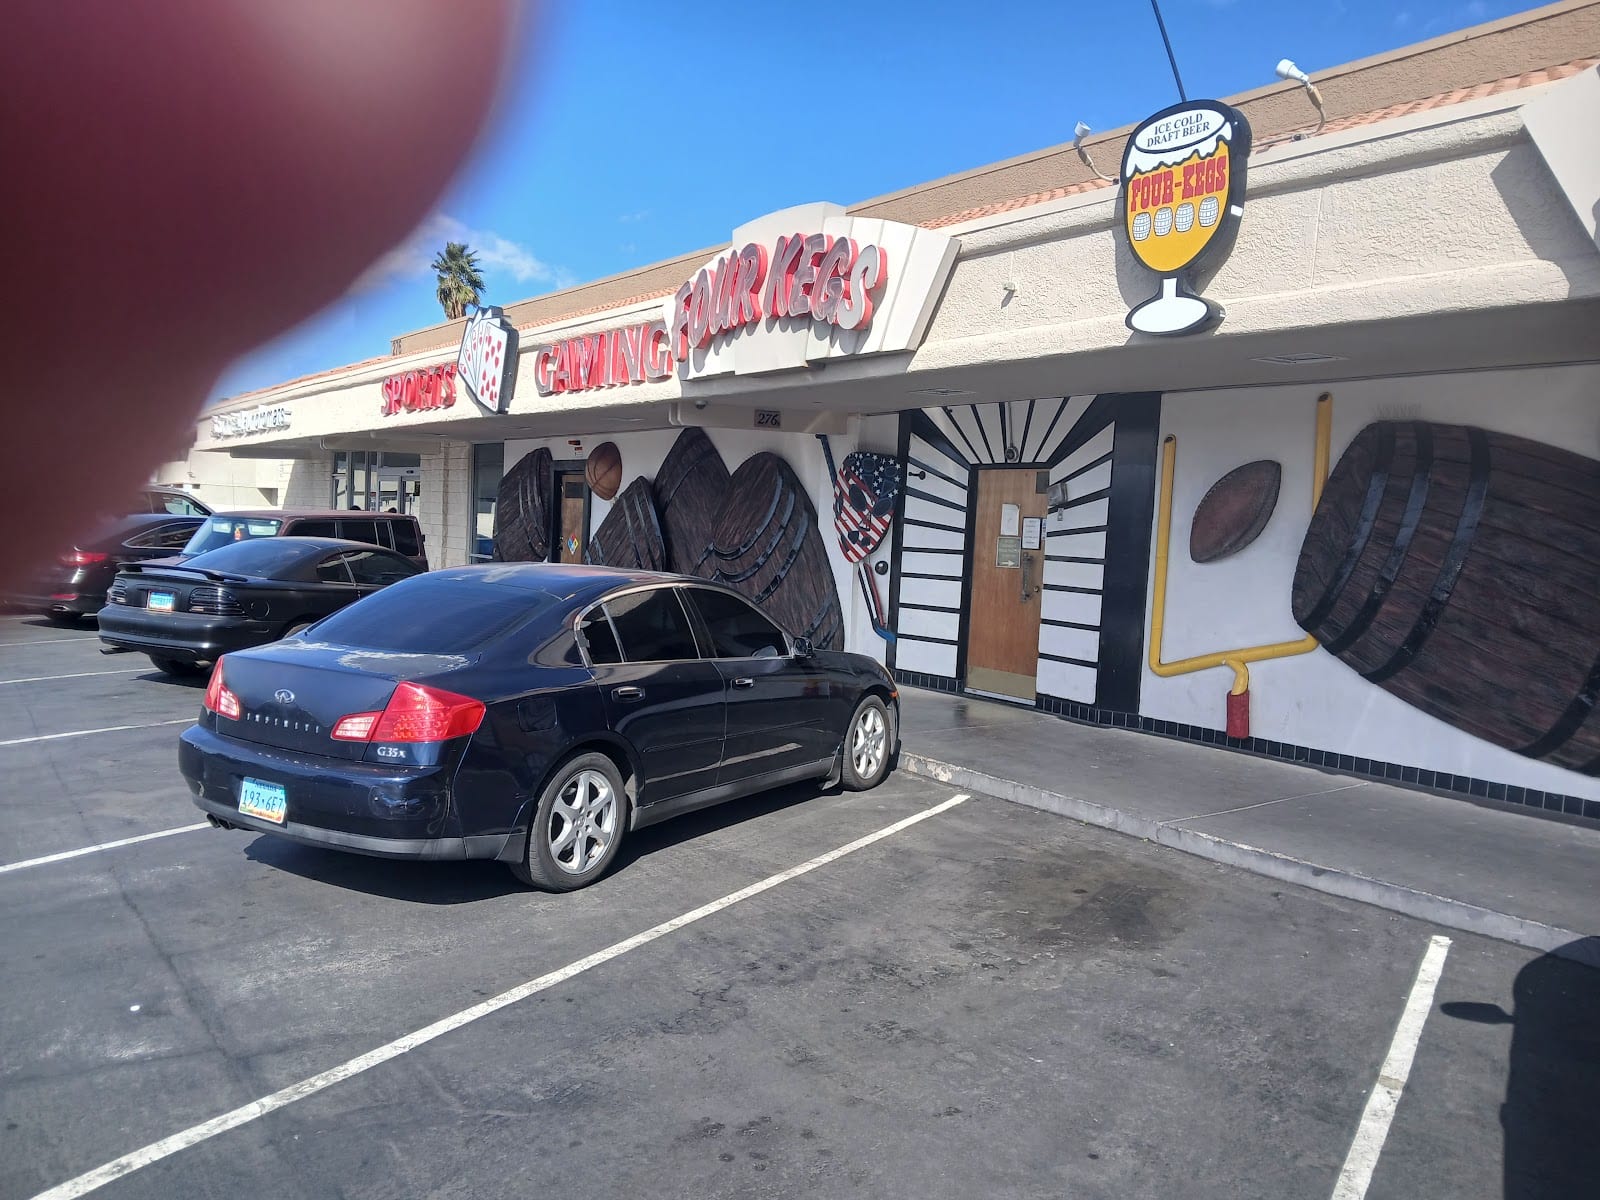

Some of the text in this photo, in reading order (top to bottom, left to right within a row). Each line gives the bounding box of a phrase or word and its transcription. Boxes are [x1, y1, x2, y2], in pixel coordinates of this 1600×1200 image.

[1147, 121, 1210, 147] DRAFT BEER
[1154, 113, 1203, 135] ICE COLD
[1130, 155, 1227, 212] FOUR-KEGS
[671, 232, 888, 362] FOUR KEGS
[535, 320, 673, 394] GAMING
[381, 362, 457, 414] SPORTS
